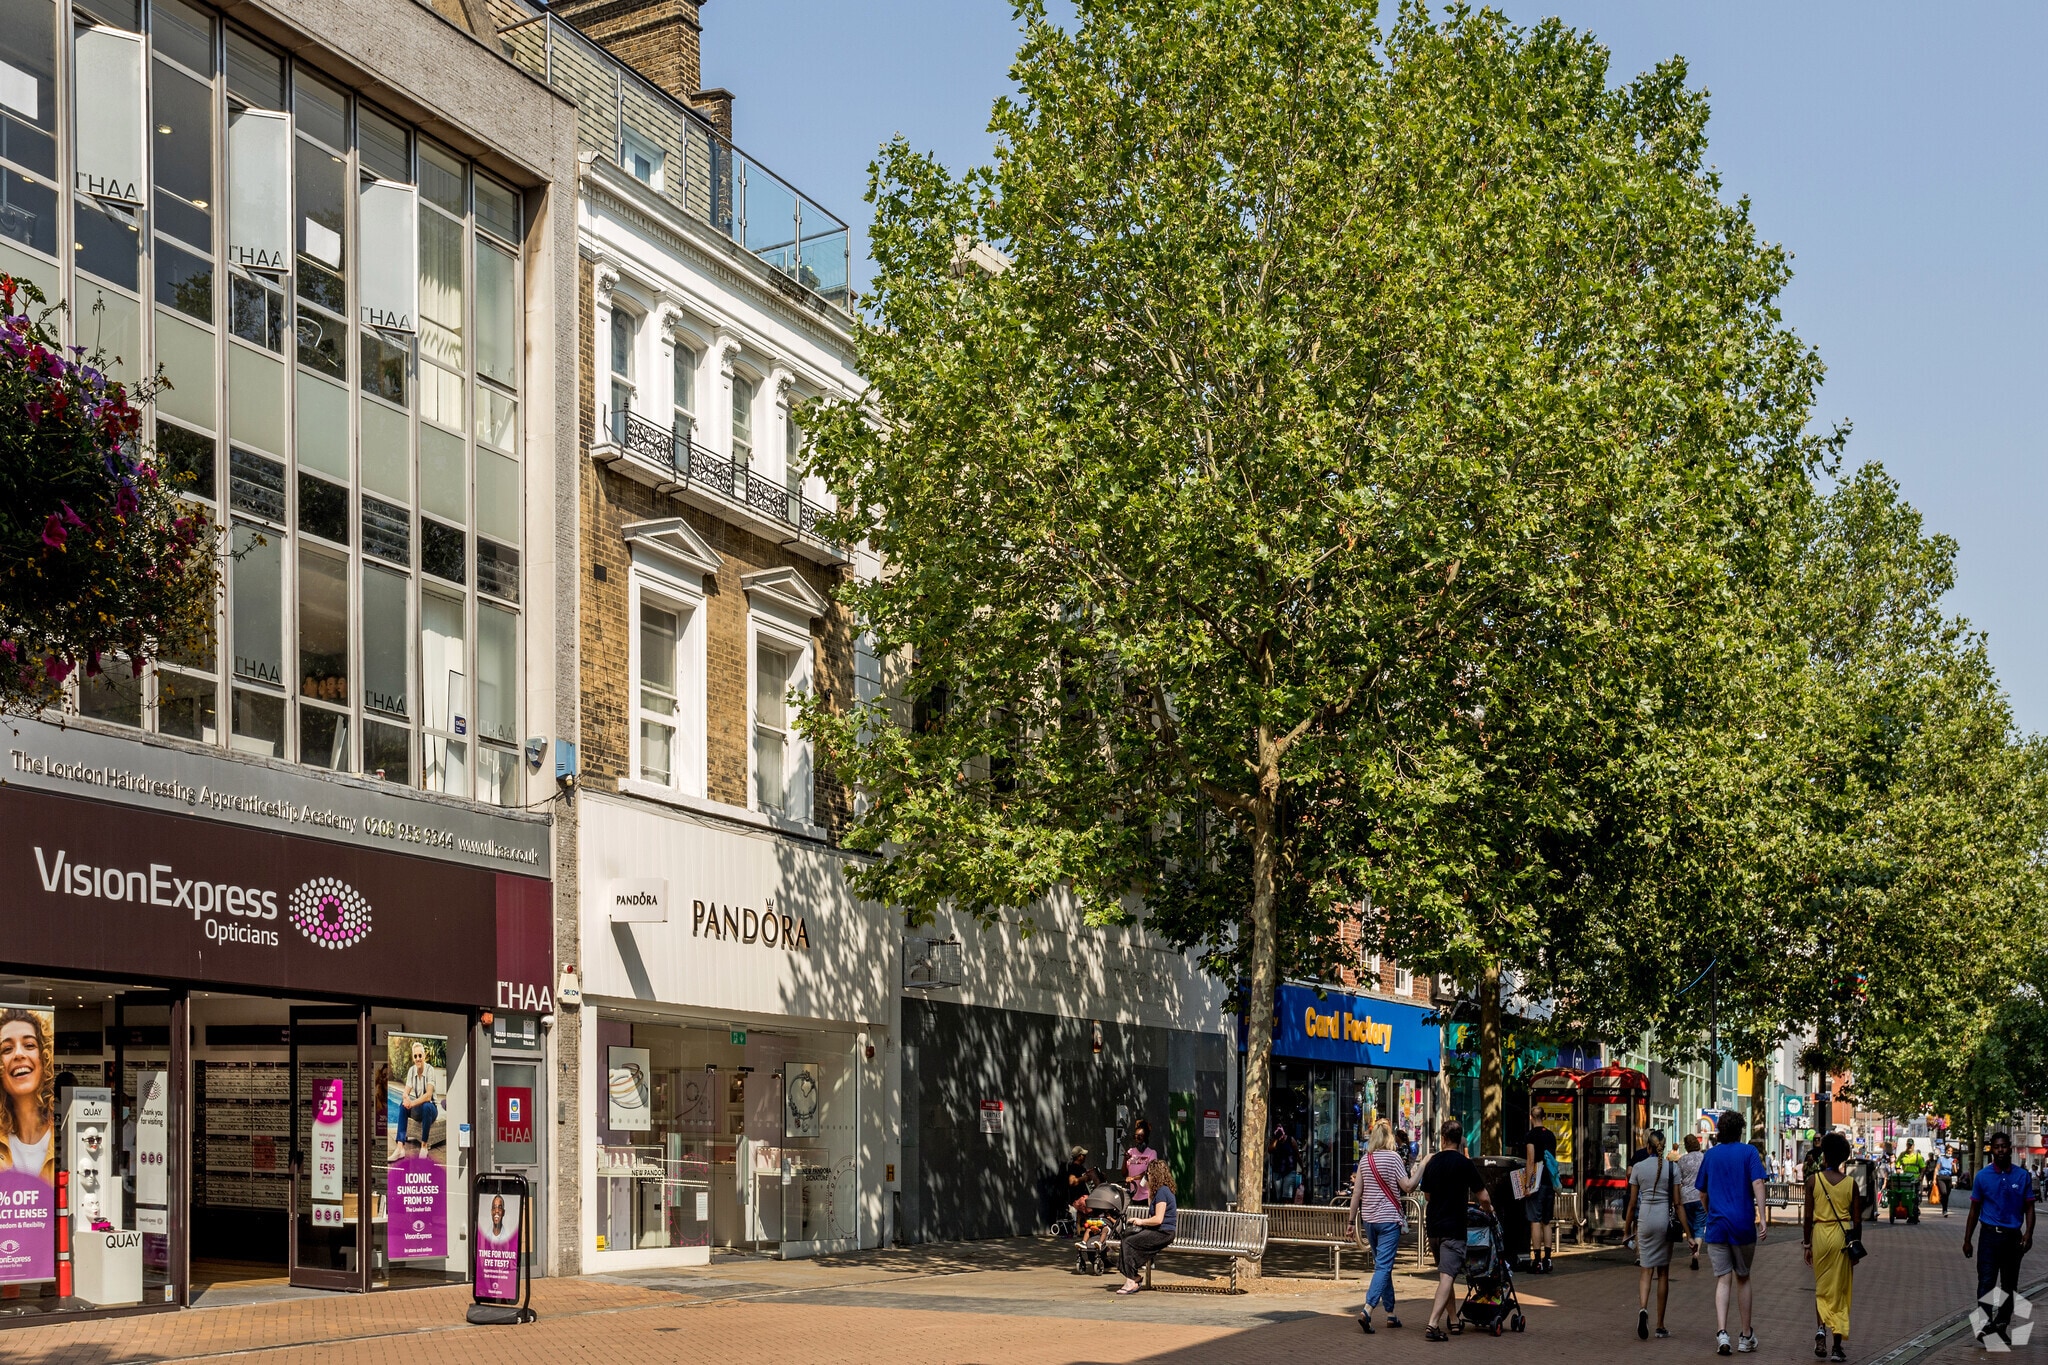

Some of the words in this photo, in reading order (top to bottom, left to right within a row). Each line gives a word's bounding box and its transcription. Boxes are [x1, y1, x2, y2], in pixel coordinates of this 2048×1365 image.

[10, 749, 44, 774] The
[45, 755, 103, 786] London
[105, 766, 197, 806] Hairdressing
[199, 785, 300, 823] Apprenticeship
[301, 804, 358, 834] Academy
[362, 815, 395, 840] 0208
[398, 823, 421, 843] 953
[424, 827, 454, 850] 9344
[616, 892, 658, 906] PANDORA
[692, 898, 811, 950] PANDORA
[205, 918, 279, 946] Opticians
[1304, 1006, 1340, 1040] Card
[1343, 1011, 1393, 1053] Factory
[83, 1108, 102, 1117] QUAY
[318, 1100, 338, 1116] £25
[148, 1119, 163, 1127] visiting
[321, 1140, 335, 1152] £75
[319, 1163, 335, 1175] £5.95
[405, 1173, 432, 1184] ICONIC
[397, 1185, 439, 1195] SUNGLASSES
[12, 1190, 39, 1206] OFF
[403, 1196, 422, 1205] FROM
[14, 1208, 48, 1219] LENSES
[23, 1221, 46, 1229] flexibility
[105, 1232, 141, 1249] QUAY
[479, 1249, 491, 1258] TIME
[491, 1250, 502, 1258] FOR
[502, 1251, 516, 1259] YOUR
[484, 1259, 494, 1267] EYE
[494, 1259, 510, 1268] TEST?
